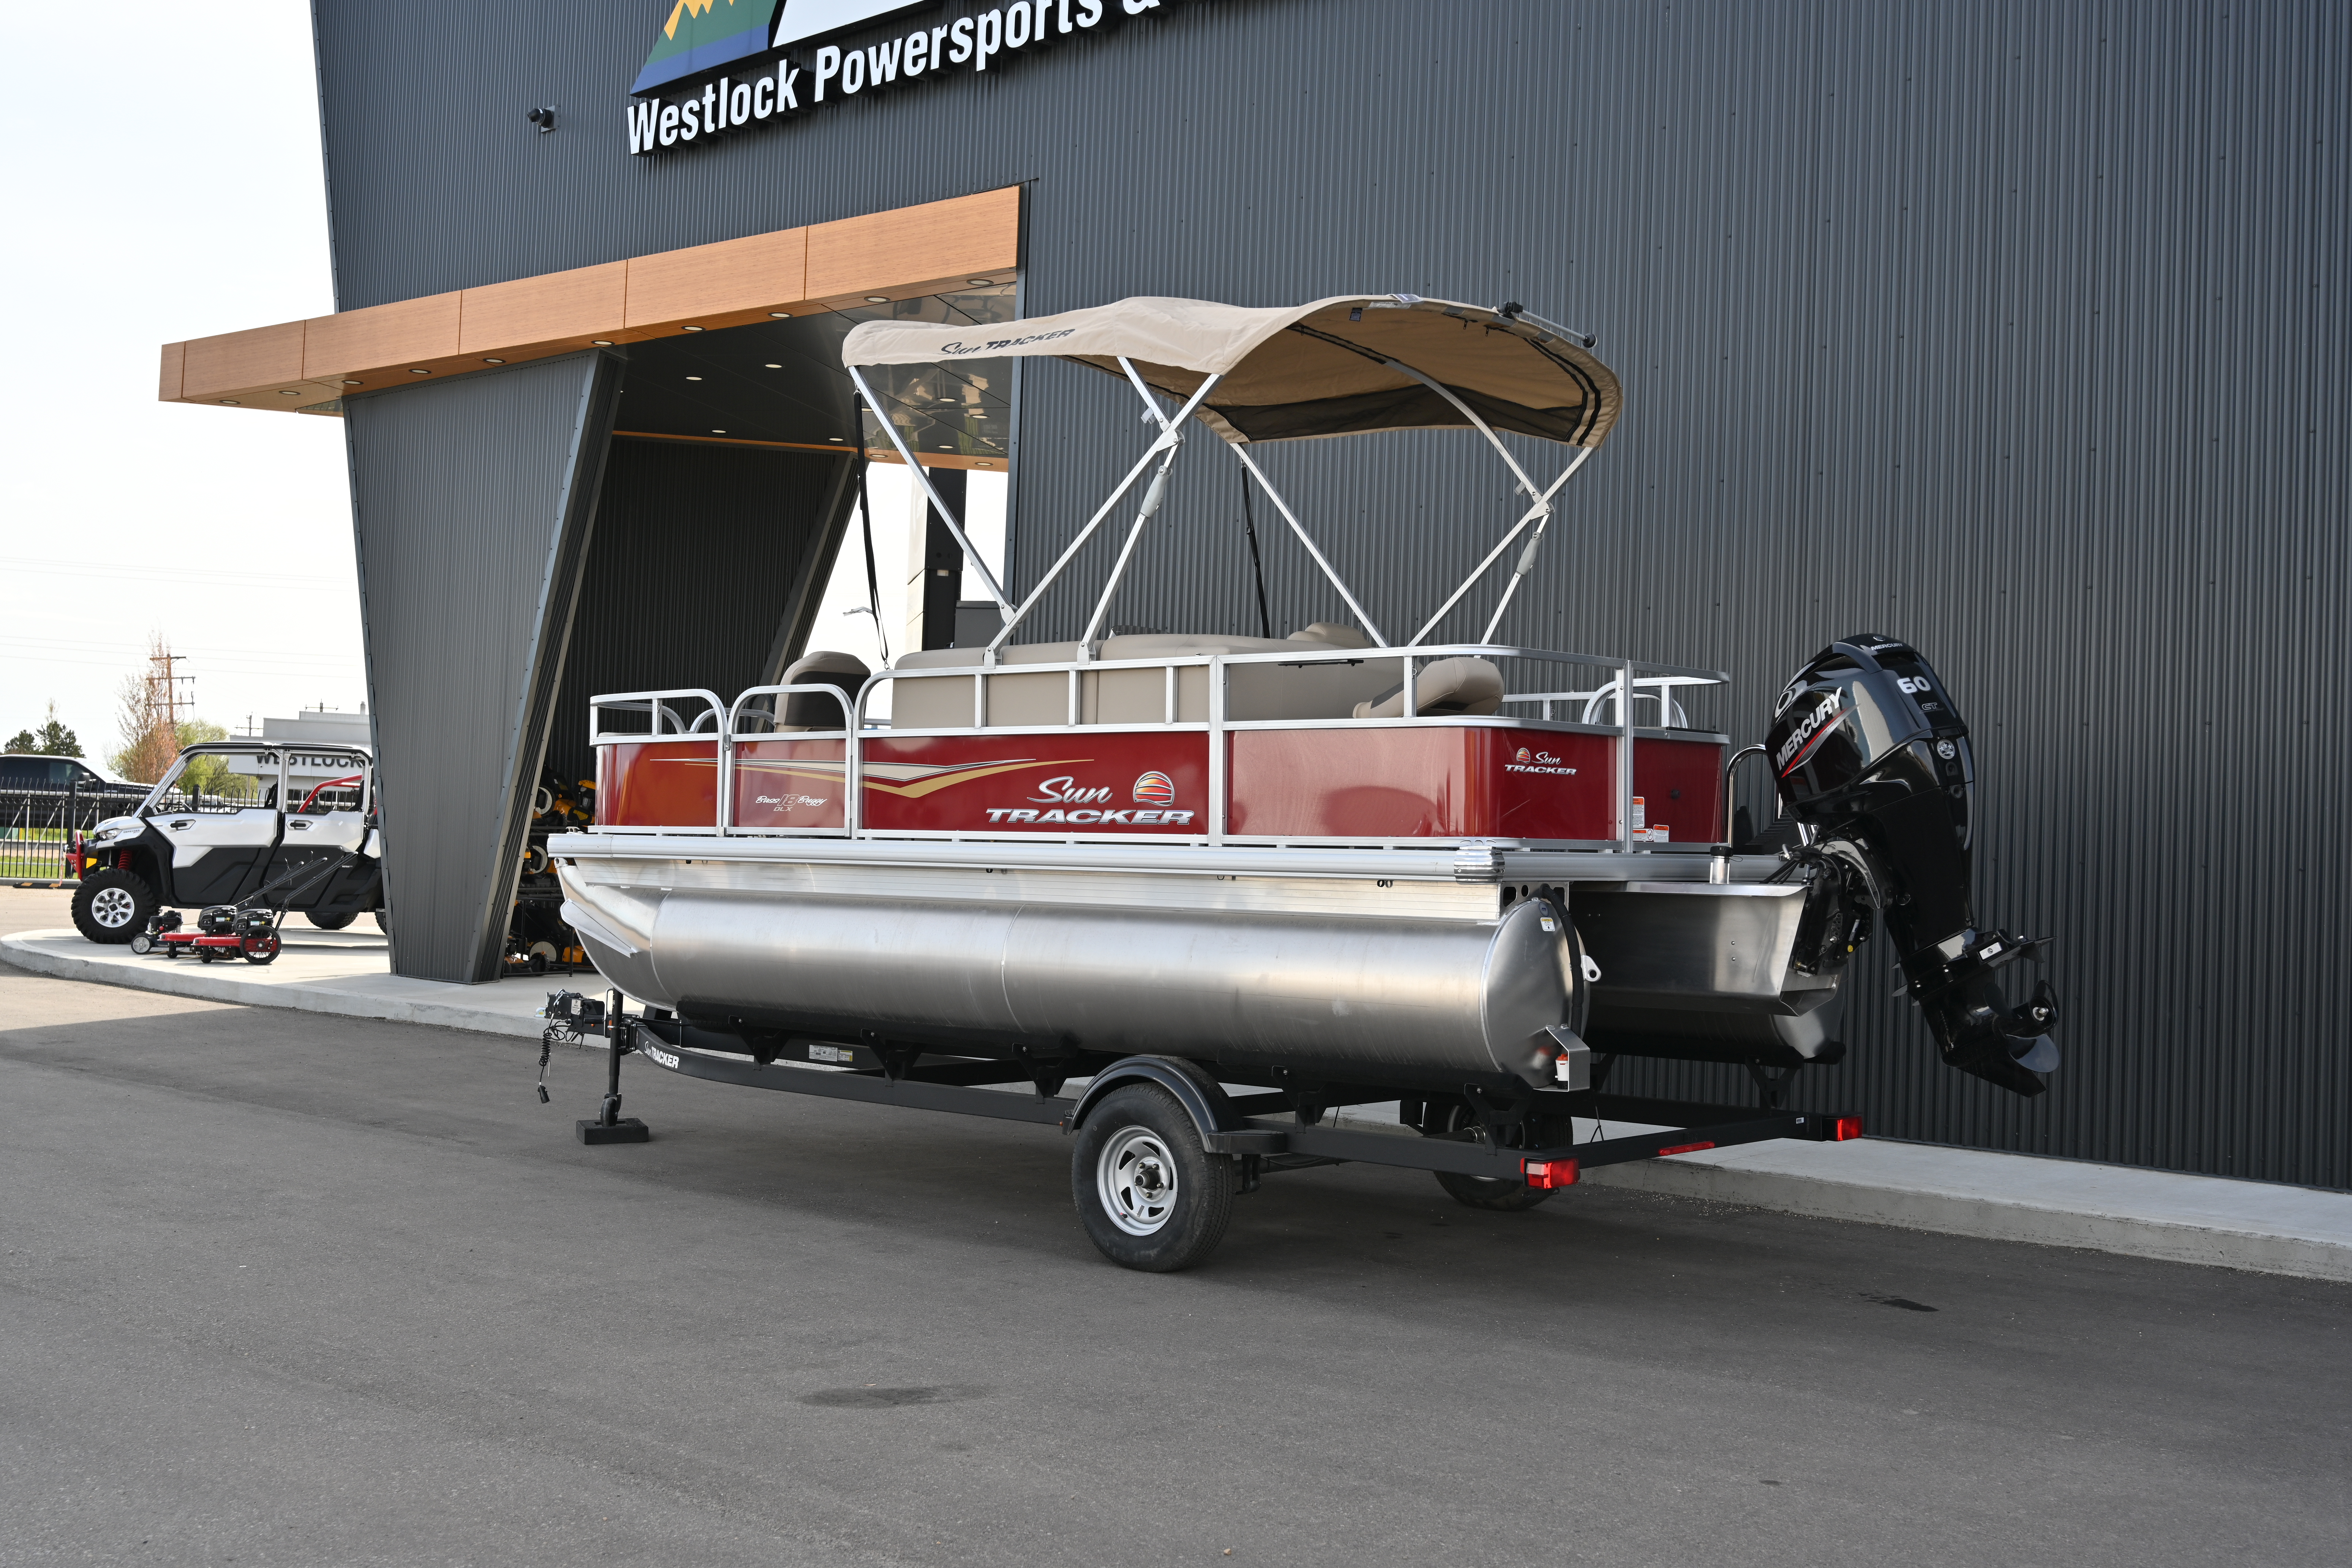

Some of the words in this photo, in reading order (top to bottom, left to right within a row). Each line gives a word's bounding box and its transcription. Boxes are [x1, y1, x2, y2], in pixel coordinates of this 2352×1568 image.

[627, 59, 800, 155] Westlock
[815, 0, 1103, 103] Powersports
[934, 342, 982, 355] Sun
[984, 329, 1076, 351] TRACKER
[1870, 643, 1903, 651] MERCURY
[1897, 676, 1932, 694] 60
[1776, 686, 1842, 771] MERCURY
[1531, 751, 1562, 765] Sun
[1505, 764, 1577, 775] TRACKER
[1027, 776, 1113, 804] Sun
[777, 794, 800, 806] 18
[797, 795, 828, 806] Buggy
[986, 809, 1195, 825] TRACKER
[651, 1046, 680, 1069] TRACKER
